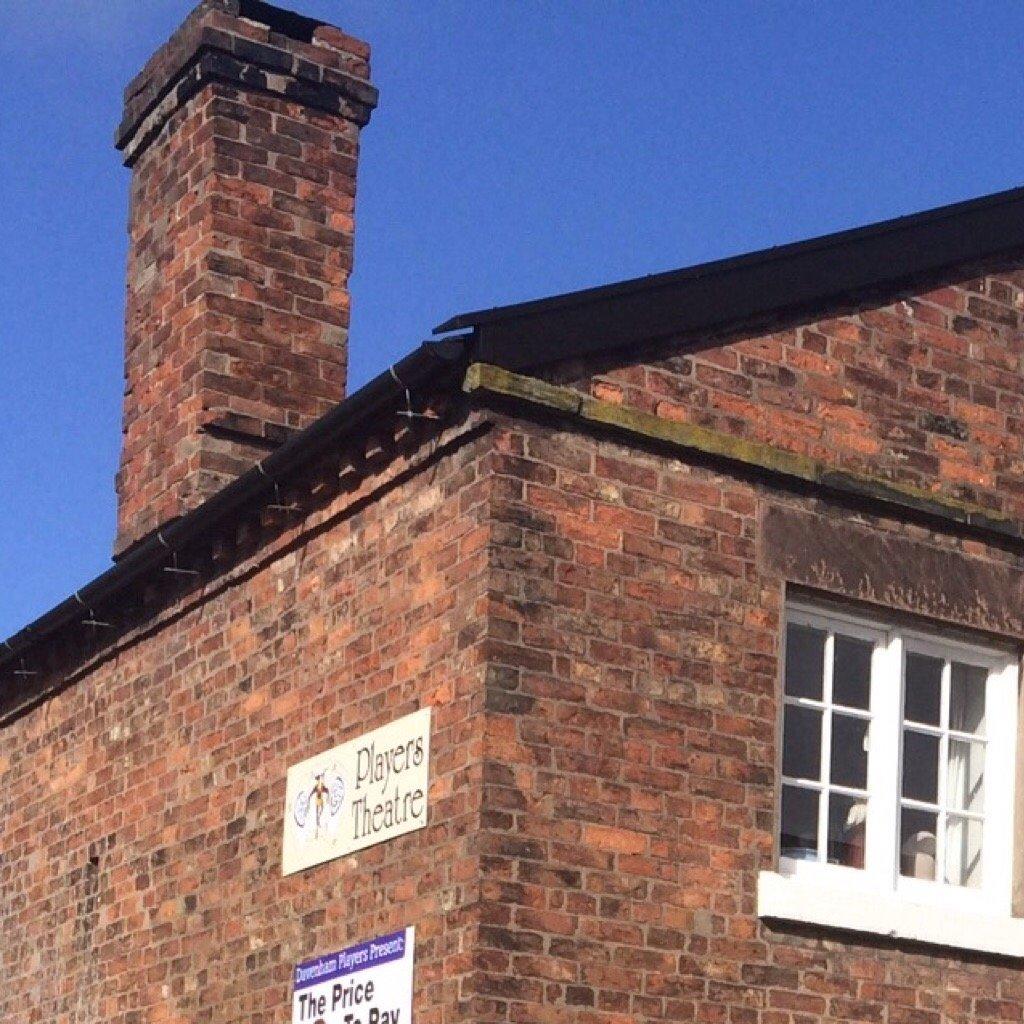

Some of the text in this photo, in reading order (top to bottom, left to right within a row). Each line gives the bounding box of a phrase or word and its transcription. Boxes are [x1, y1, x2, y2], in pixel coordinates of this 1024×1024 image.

[355, 736, 424, 794] Players
[352, 786, 424, 840] Theatre
[298, 978, 375, 1021] The Price
